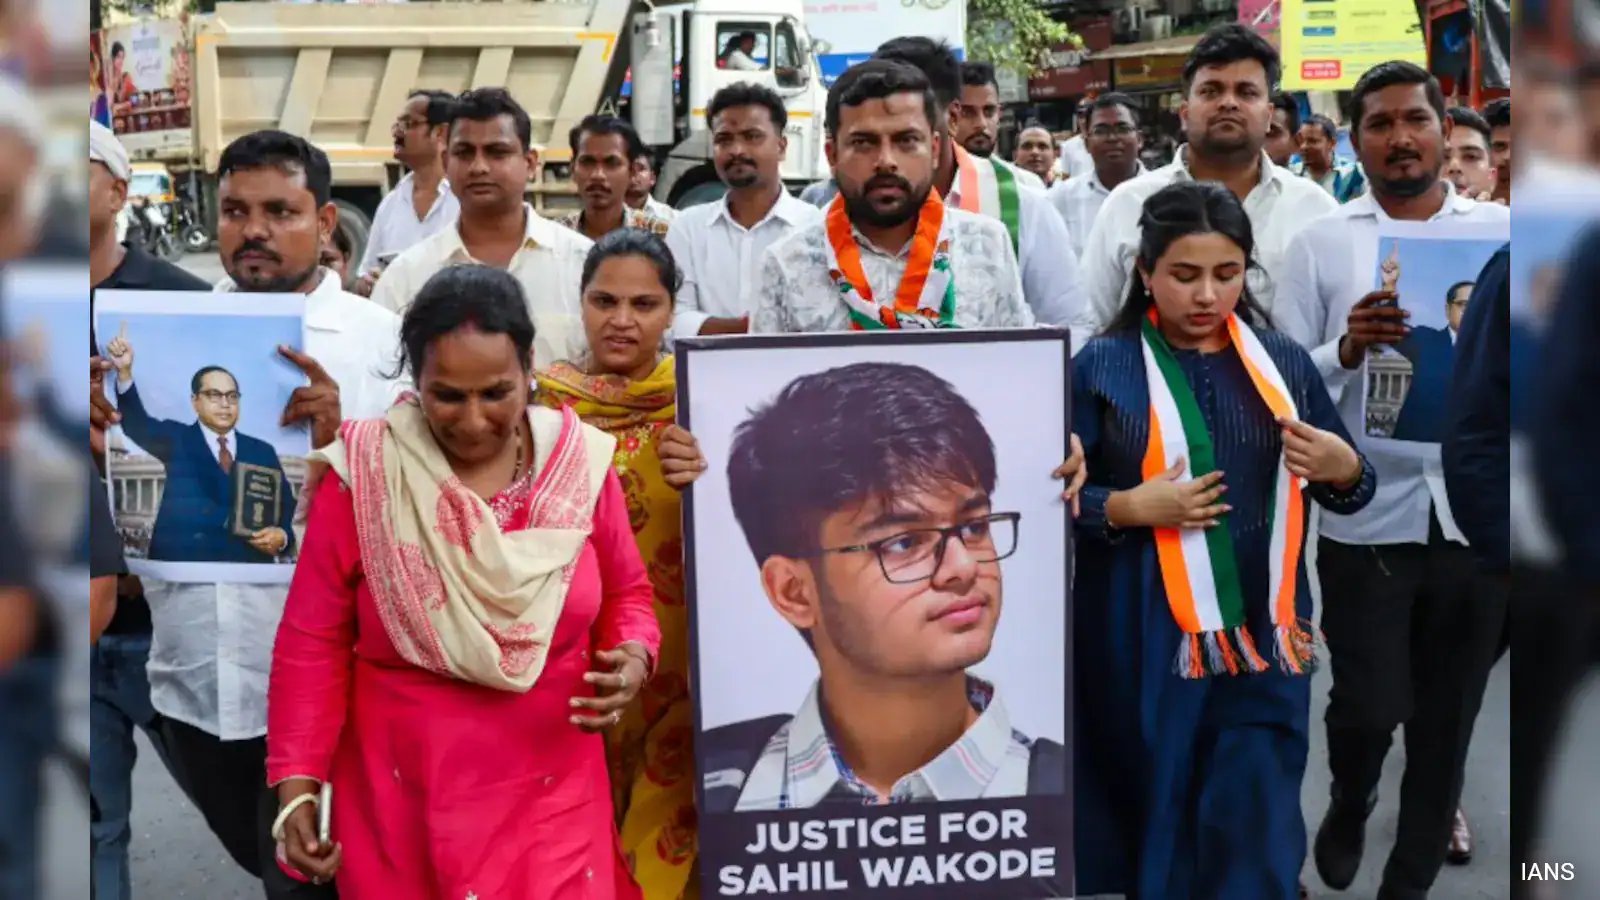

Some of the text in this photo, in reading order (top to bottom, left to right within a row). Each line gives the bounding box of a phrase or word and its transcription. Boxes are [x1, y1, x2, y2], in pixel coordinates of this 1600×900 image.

[745, 808, 1027, 854] JUSTICE FOR
[718, 847, 1056, 896] SAHIL WAKODE
